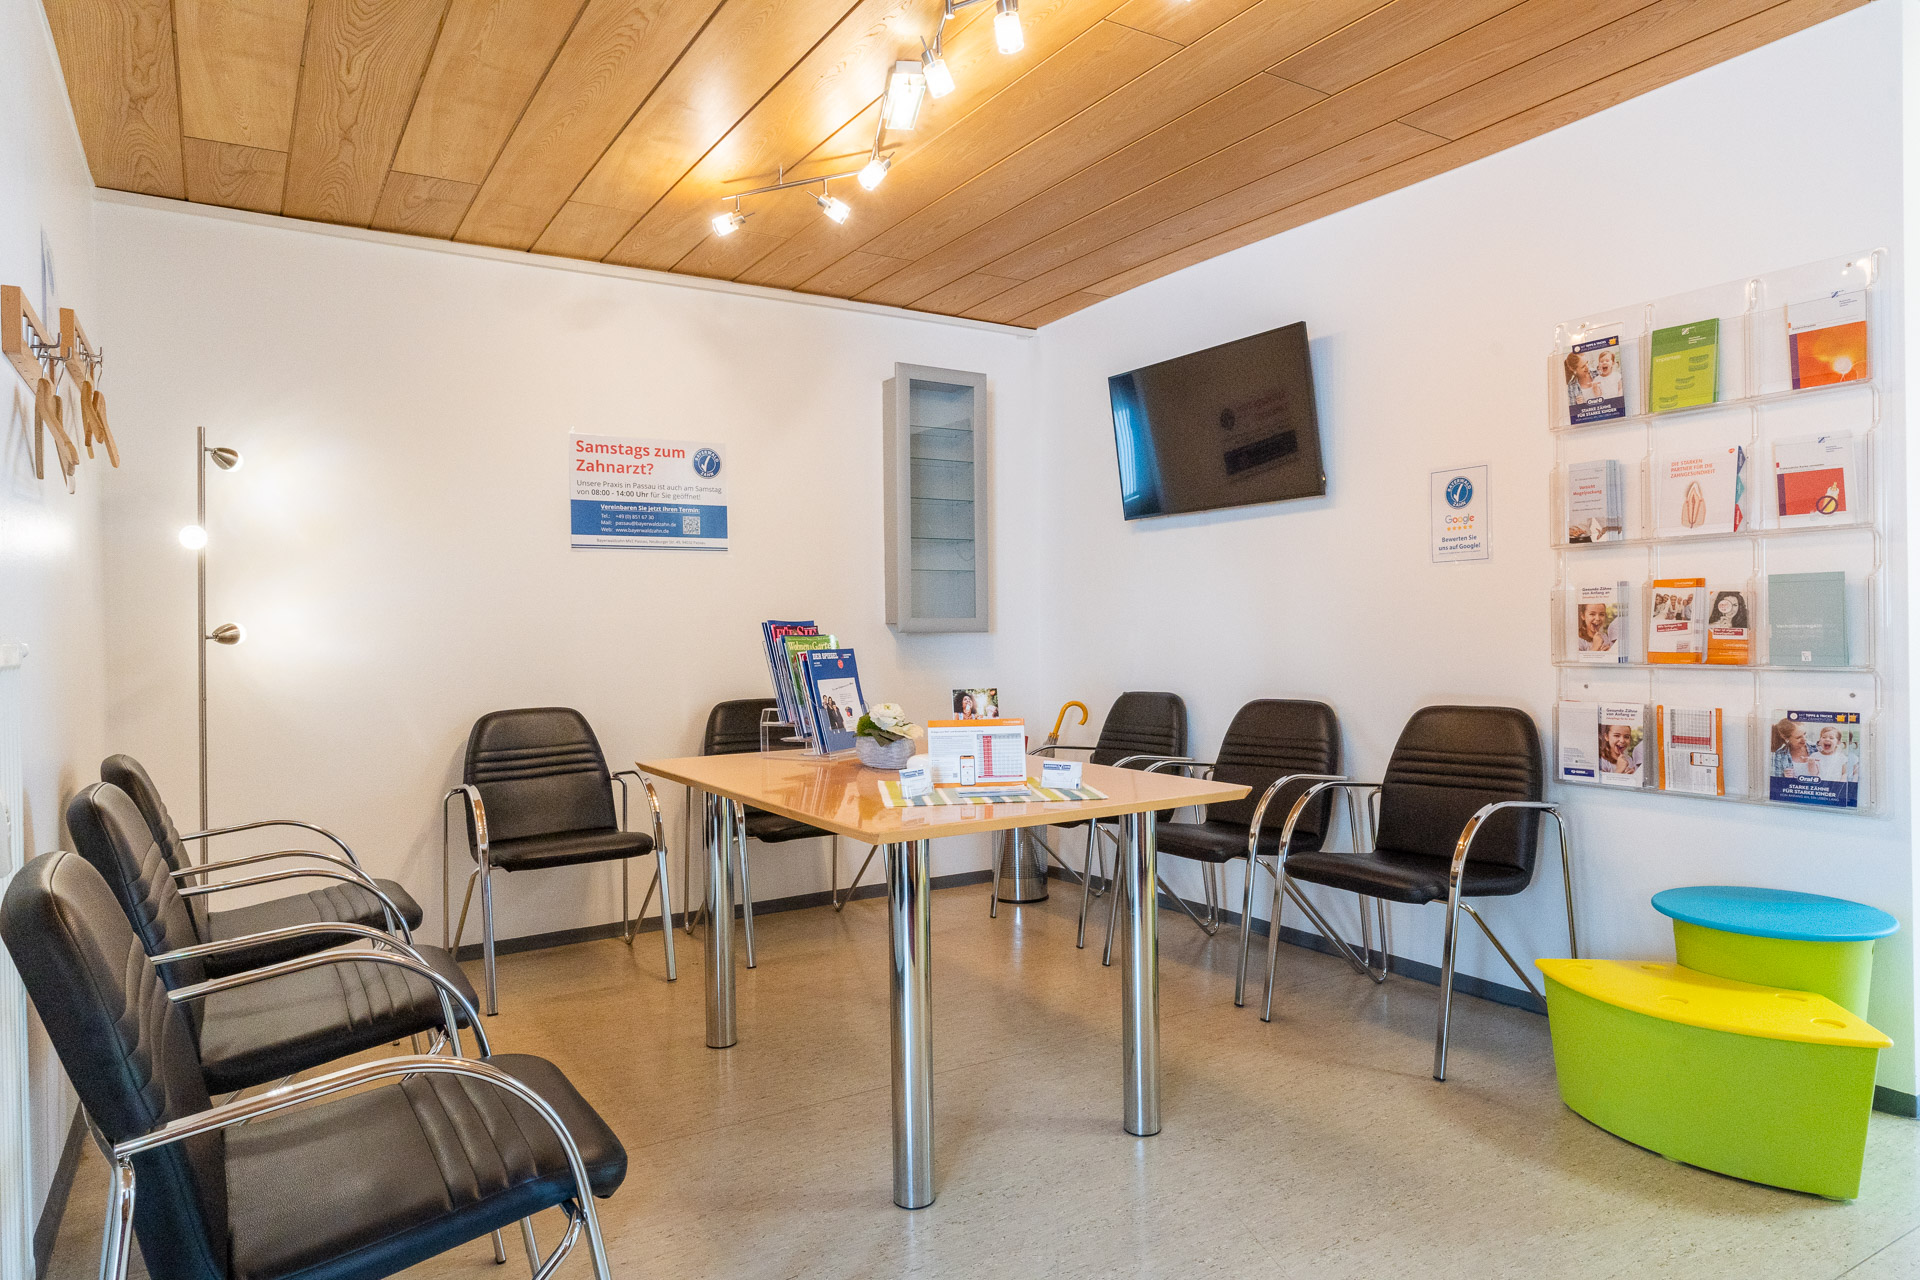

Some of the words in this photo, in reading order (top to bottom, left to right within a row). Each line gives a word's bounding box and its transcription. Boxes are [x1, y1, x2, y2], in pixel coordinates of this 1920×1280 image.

[1587, 397, 1603, 405] Oral-B
[575, 440, 650, 460] Samstags
[653, 447, 686, 459] zum
[575, 459, 654, 475] Zahnarzt?
[1680, 458, 1703, 466] STARKEN
[1670, 465, 1692, 473] PARTNER
[1670, 468, 1716, 479] ZAHNGESUNDHEIT
[576, 479, 601, 487] Unsere
[602, 480, 624, 488] Praxis
[624, 481, 632, 489] in
[632, 482, 656, 490] Passau
[694, 485, 722, 494] Samstag
[590, 489, 611, 497] 08:00
[616, 490, 635, 498] 14:00
[635, 490, 649, 498] Uhr
[650, 491, 660, 499] für
[661, 491, 672, 499] Sie
[672, 492, 701, 501] geöffnet!
[600, 503, 638, 511] Vereinbaren
[648, 505, 662, 513] jetzt
[615, 520, 677, 528] passau@bayerwaldzahn.de
[1444, 513, 1475, 525] Google
[1441, 535, 1468, 543] Bewerten
[1458, 542, 1481, 550] Google!
[787, 641, 810, 651] Wohnen
[812, 641, 835, 650] Garte
